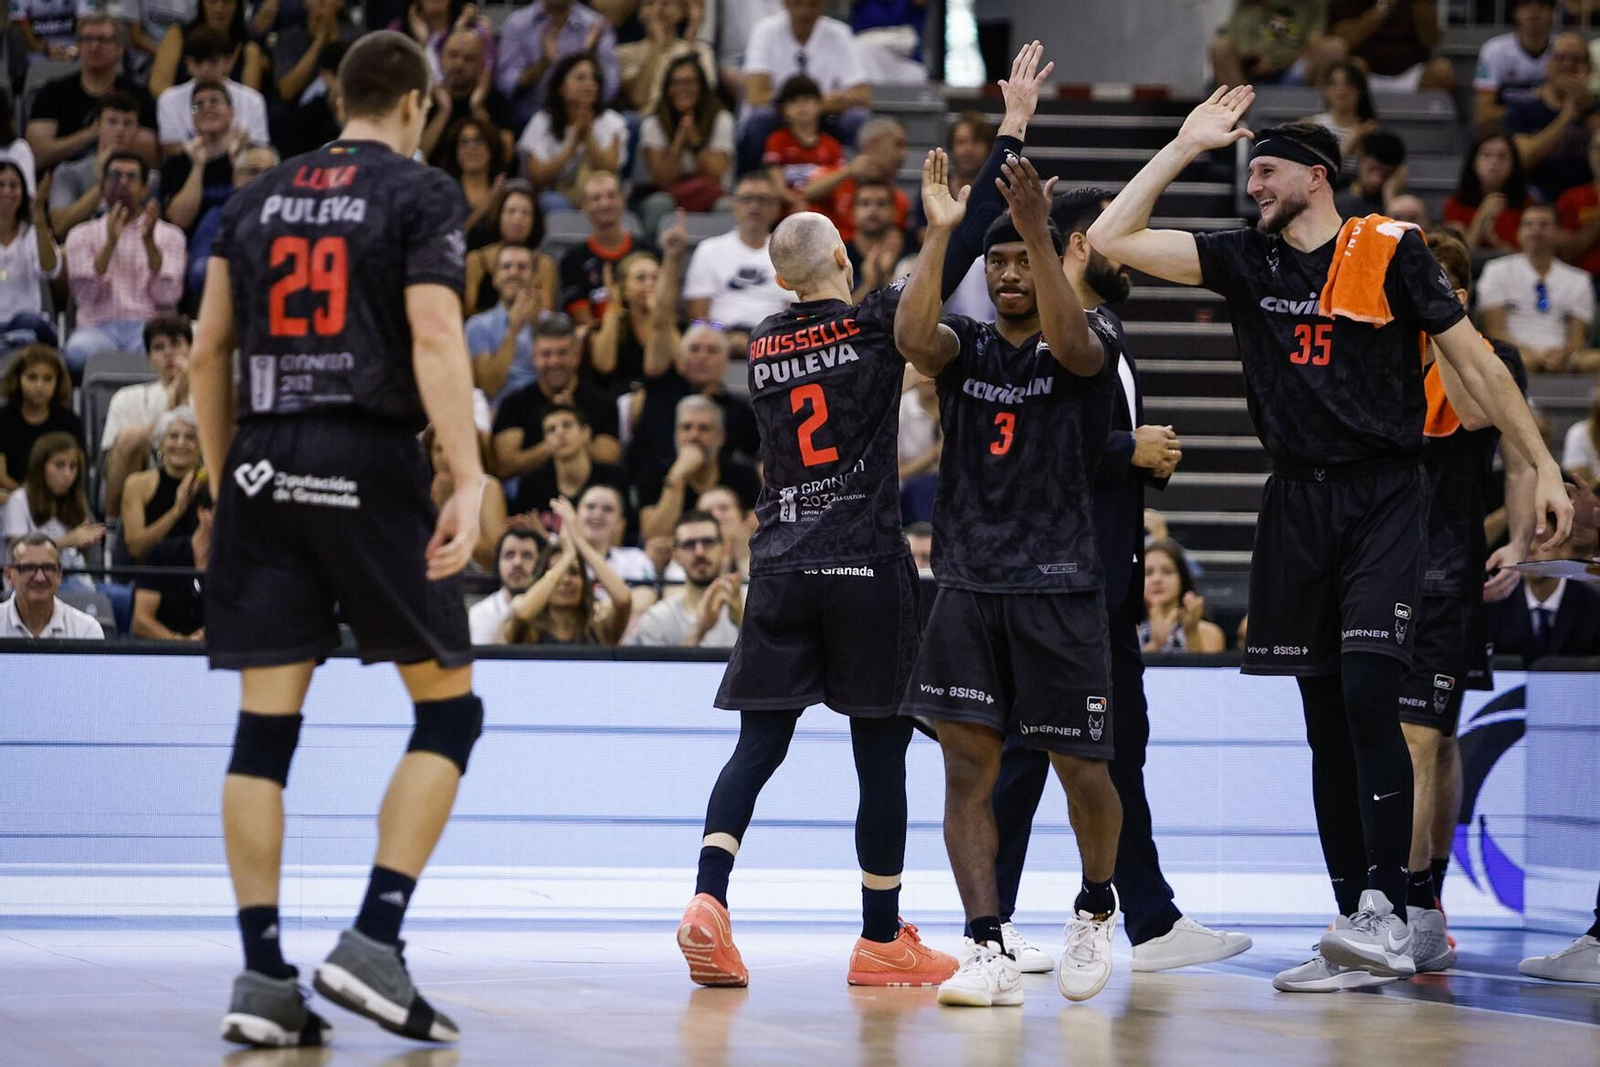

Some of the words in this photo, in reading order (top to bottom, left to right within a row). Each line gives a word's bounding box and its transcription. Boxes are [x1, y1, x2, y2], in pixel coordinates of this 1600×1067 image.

[260, 194, 366, 224] PULEVA
[268, 235, 348, 336] 29
[753, 343, 860, 390] PULEVA
[1289, 324, 1333, 366] 35
[790, 383, 839, 467] 2
[989, 411, 1015, 455] 3
[920, 683, 945, 696] vive
